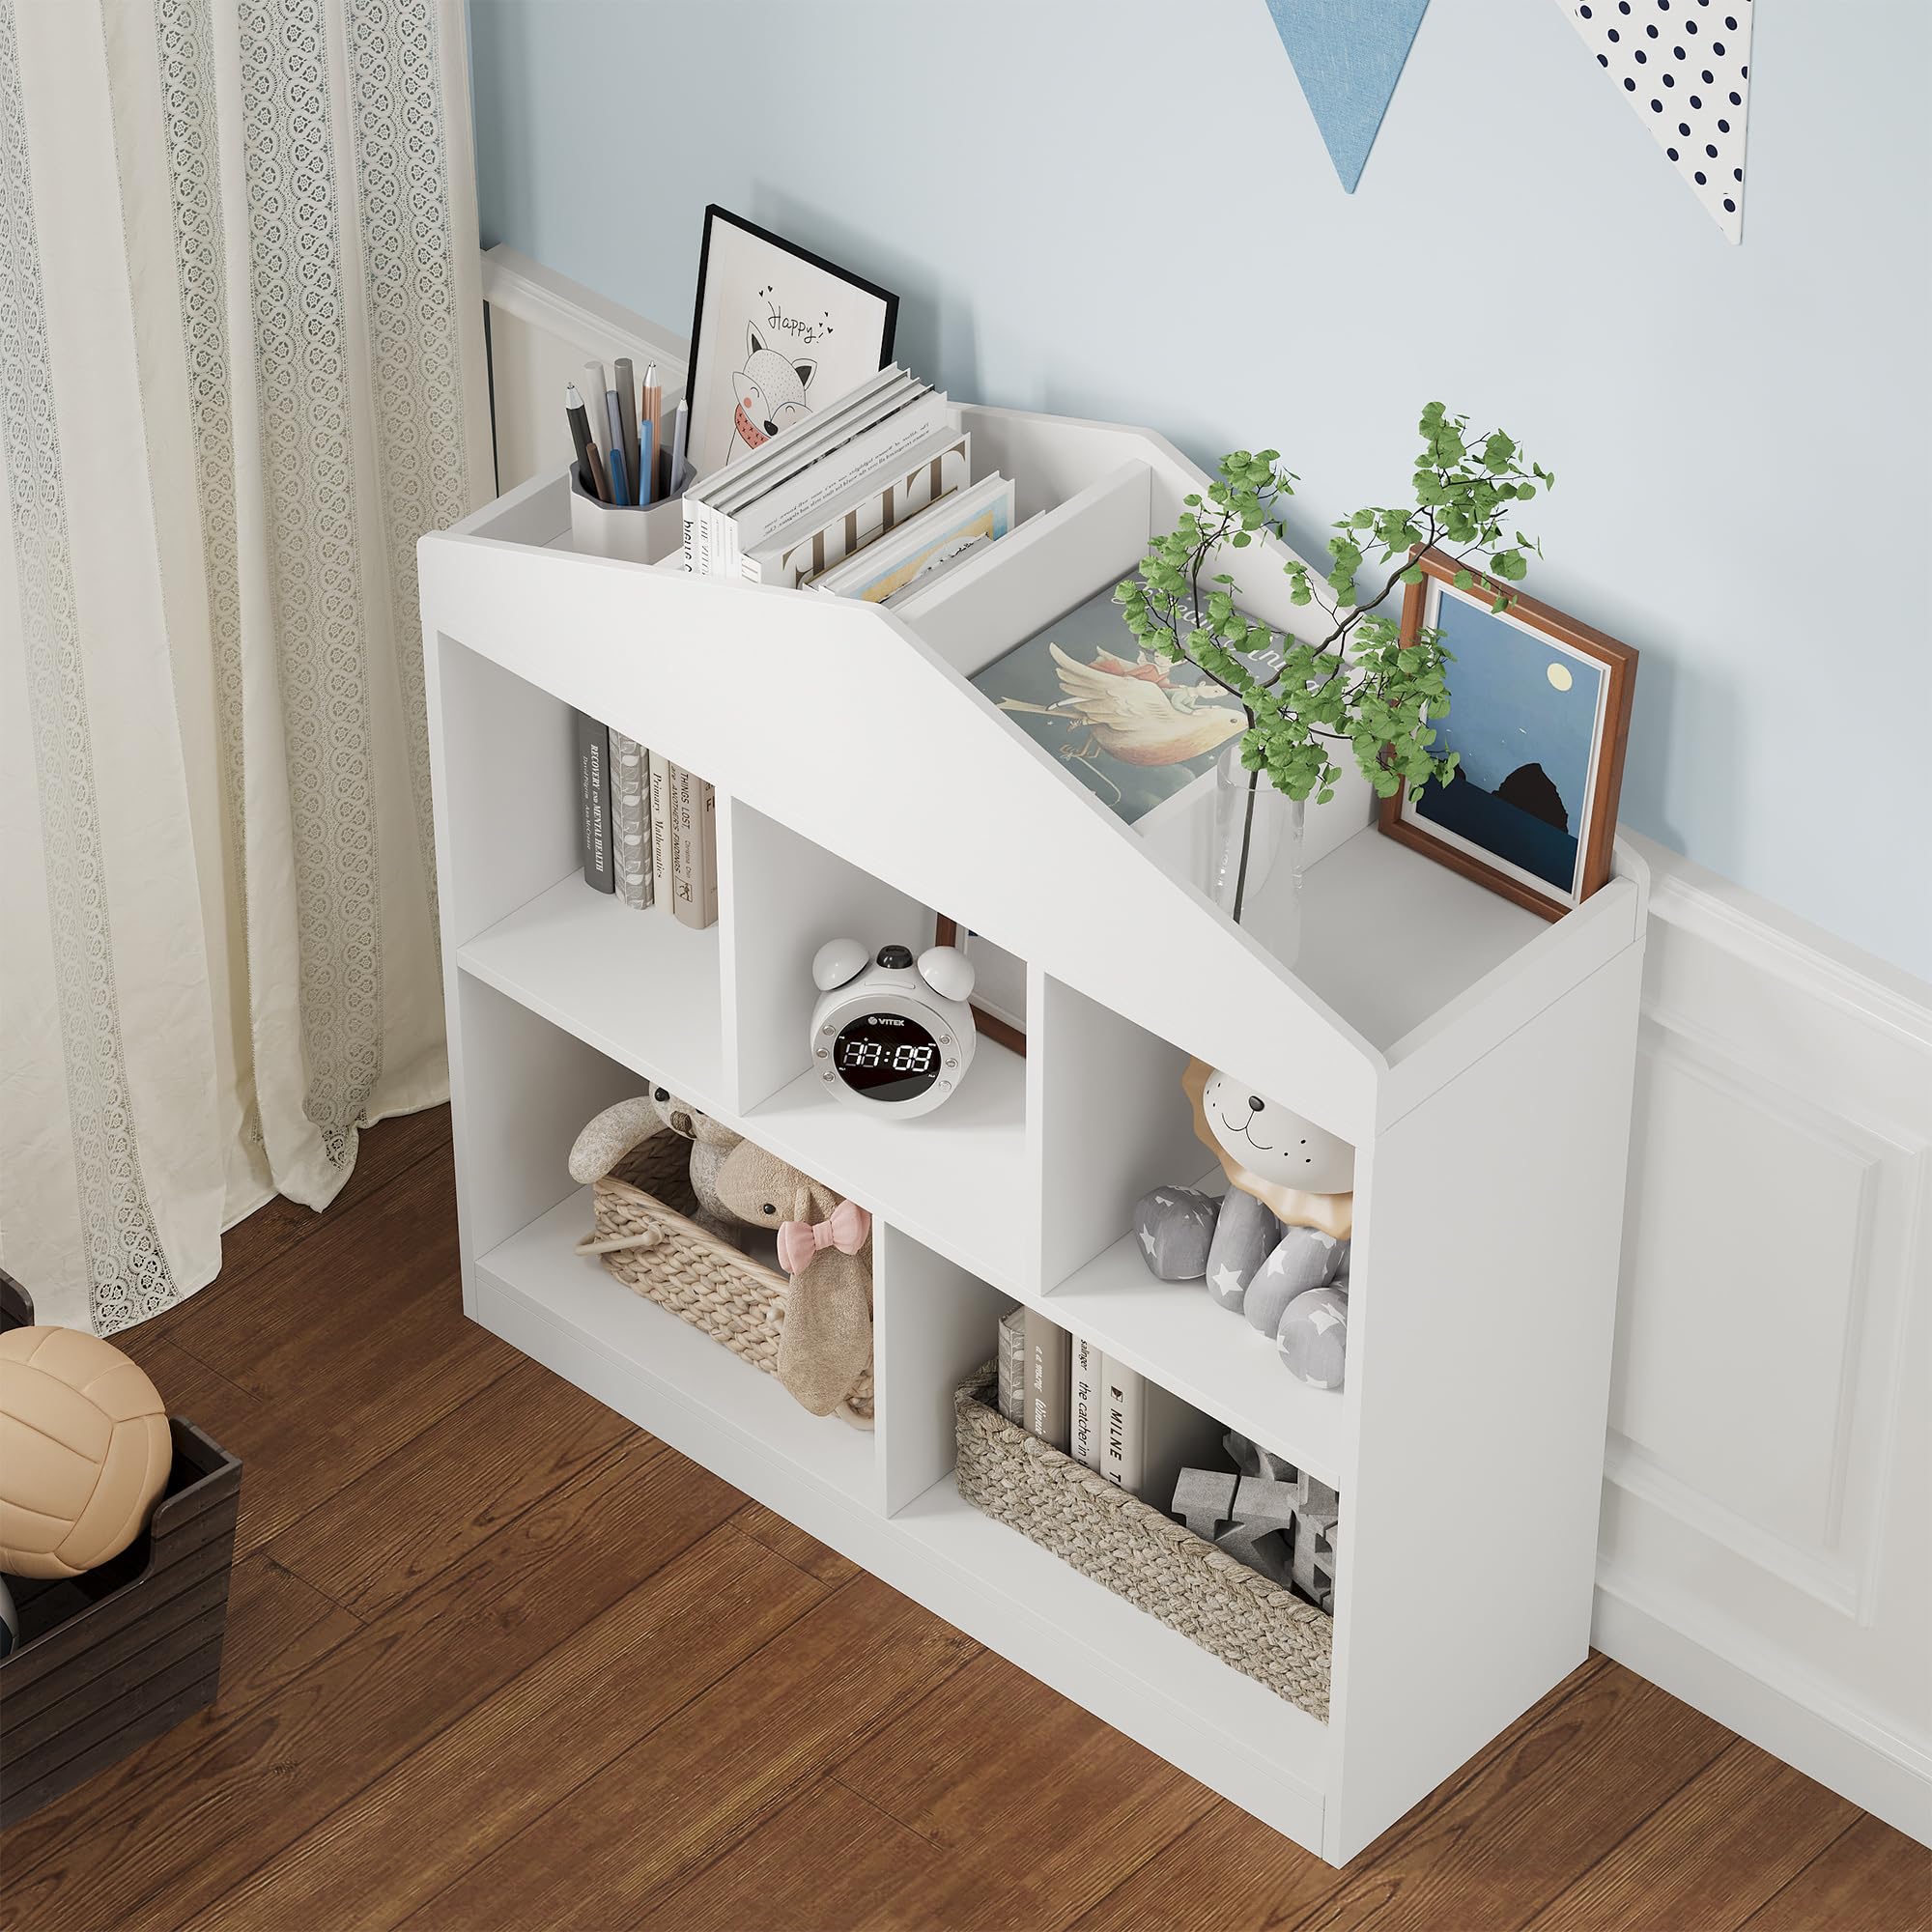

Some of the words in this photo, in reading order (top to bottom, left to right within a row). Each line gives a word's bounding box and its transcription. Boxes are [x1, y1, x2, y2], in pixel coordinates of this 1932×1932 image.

[590, 744, 600, 790] RECOVERY
[652, 772, 663, 811] Primary
[680, 772, 690, 804] THINGS
[593, 804, 602, 838] MENTAL
[878, 1018, 905, 1027] VITEK
[1078, 1380, 1093, 1401] the
[1078, 1402, 1092, 1445] catcher
[1110, 1408, 1123, 1462] MILNE
